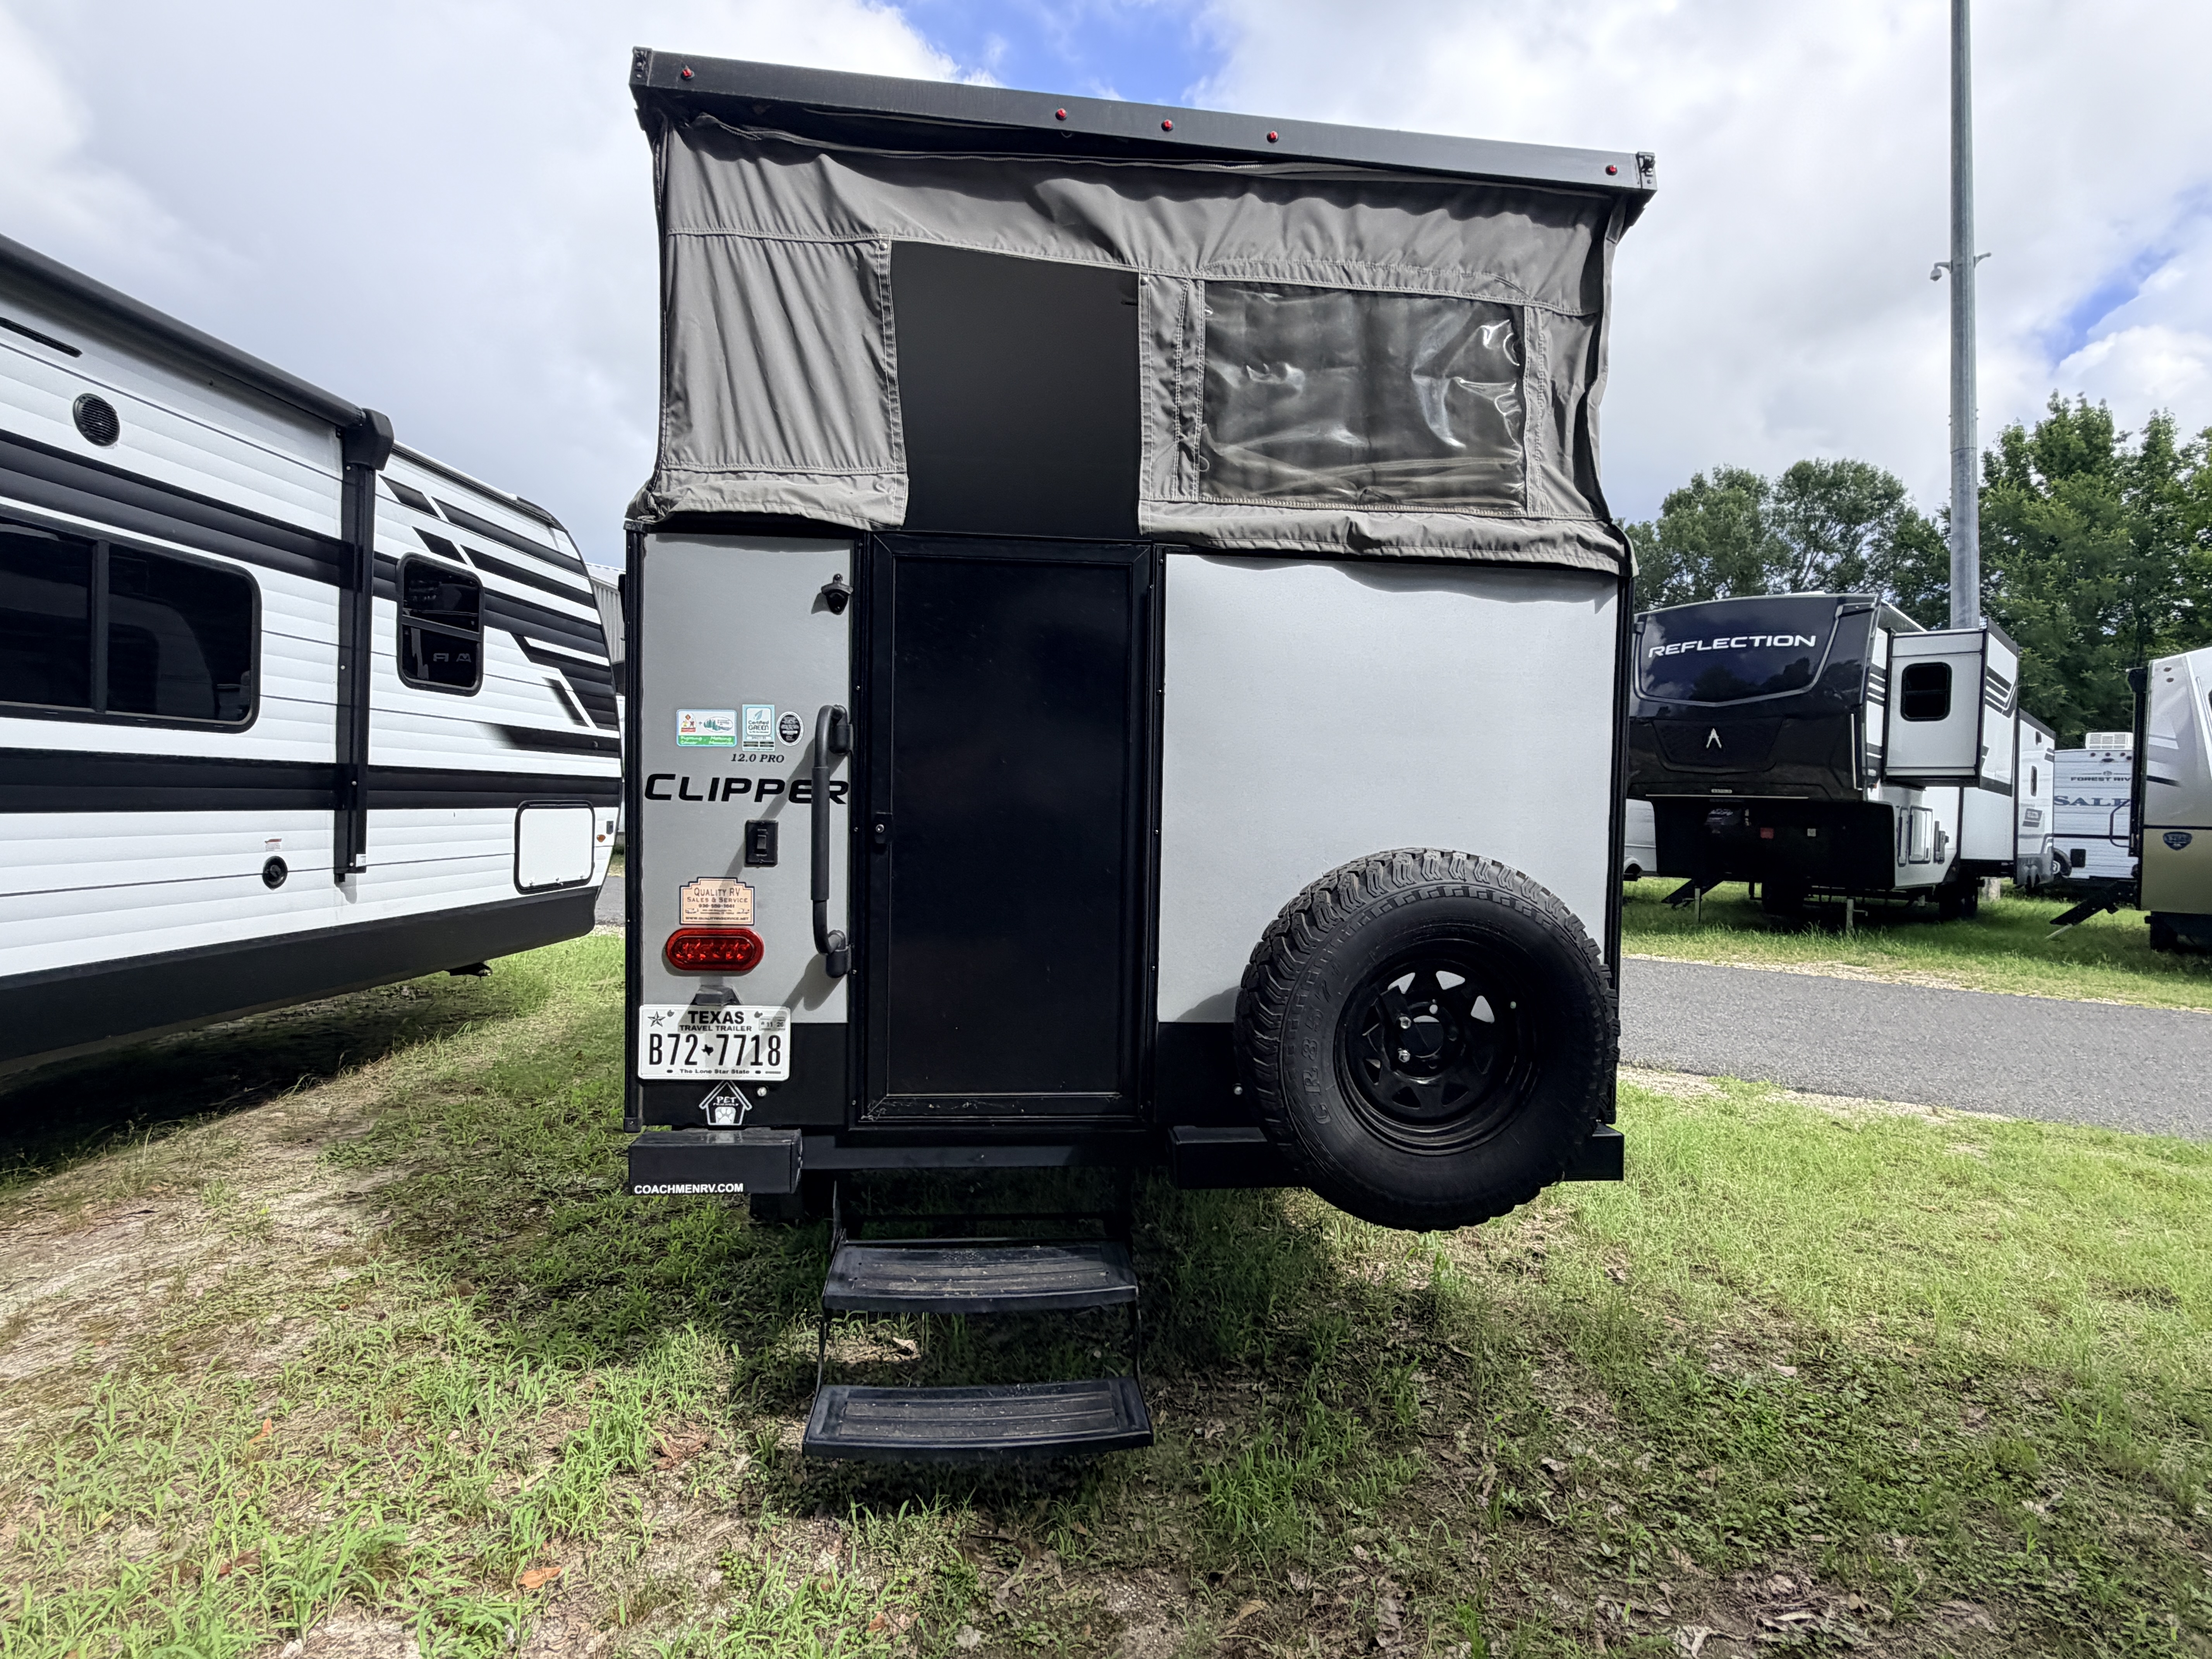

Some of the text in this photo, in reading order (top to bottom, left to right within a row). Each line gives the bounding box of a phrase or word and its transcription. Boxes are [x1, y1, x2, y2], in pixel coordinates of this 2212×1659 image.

[1648, 635, 1816, 658] REFLECTION
[731, 753, 785, 763] 12.0 PRO
[644, 774, 849, 804] CLIPPER
[2054, 796, 2130, 807] SALE
[694, 887, 740, 896] QUALITY RV
[688, 1011, 744, 1024] TEXAS
[649, 1033, 781, 1066] B72 7718
[634, 1183, 744, 1194] COACHMENRV.COM
